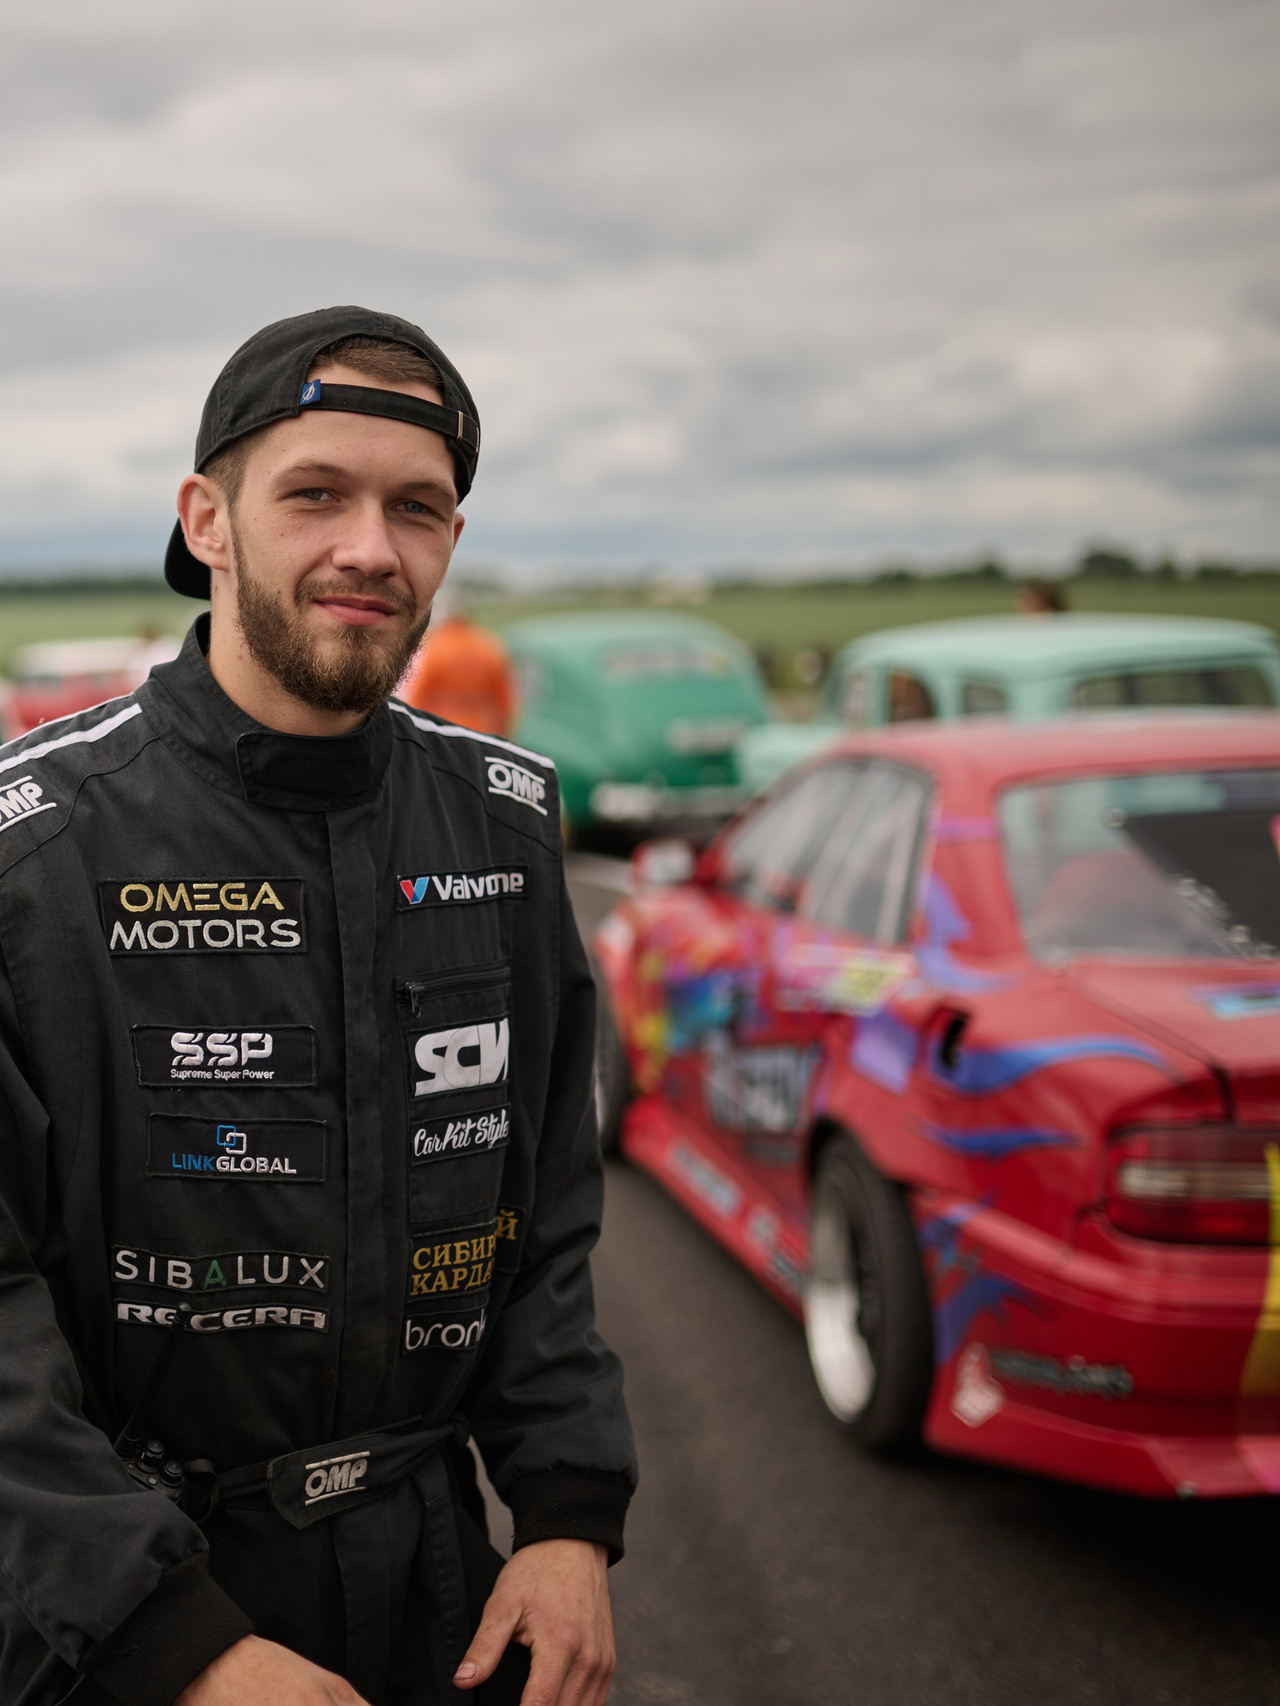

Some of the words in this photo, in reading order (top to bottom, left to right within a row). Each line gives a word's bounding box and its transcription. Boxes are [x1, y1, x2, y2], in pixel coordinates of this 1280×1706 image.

[487, 763, 545, 804] OMP
[120, 882, 284, 912] OMEGA
[109, 918, 301, 950] MOTORS
[170, 1032, 273, 1066] SSP
[170, 1068, 212, 1080] Supreme
[214, 1069, 241, 1081] Super
[242, 1069, 274, 1079] Power
[172, 1152, 297, 1174] LINKGLOBAL
[115, 1250, 325, 1289] SIBALUX
[410, 1258, 495, 1296] КАРДА
[305, 1459, 368, 1498] OMP
